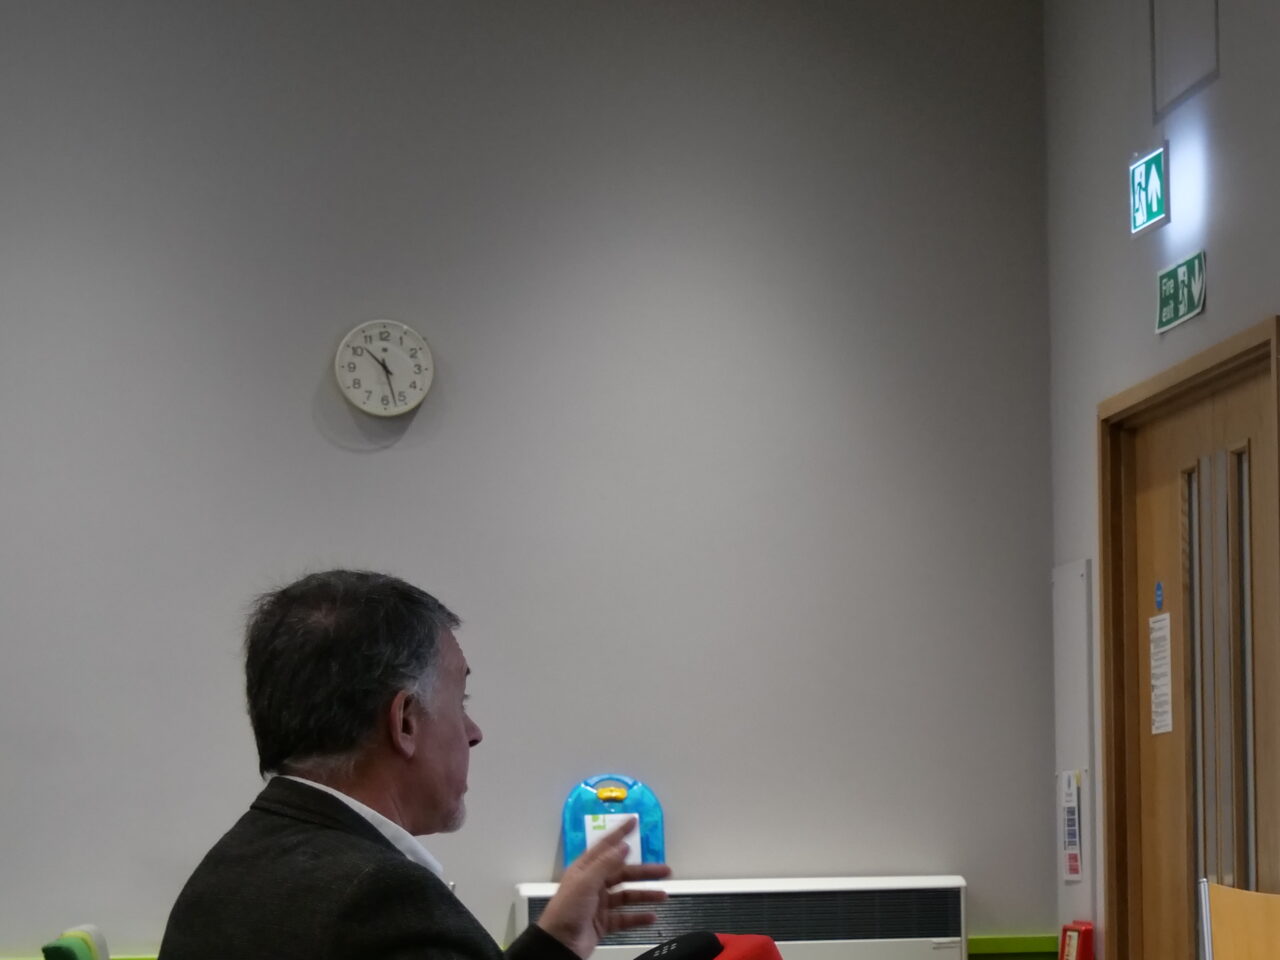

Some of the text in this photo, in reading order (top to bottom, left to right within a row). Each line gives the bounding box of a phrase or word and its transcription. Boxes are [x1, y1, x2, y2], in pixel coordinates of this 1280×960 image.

[1161, 277, 1174, 298] Fire
[1161, 299, 1174, 322] exit
[379, 330, 391, 341] 12
[352, 346, 364, 356] 10
[409, 348, 418, 359] 2
[347, 362, 356, 372] 9
[414, 364, 422, 375] 3
[352, 378, 361, 389] 8
[409, 381, 417, 390] 4
[364, 390, 373, 400] 7
[381, 395, 390, 406] 6
[399, 391, 407, 402] 5
